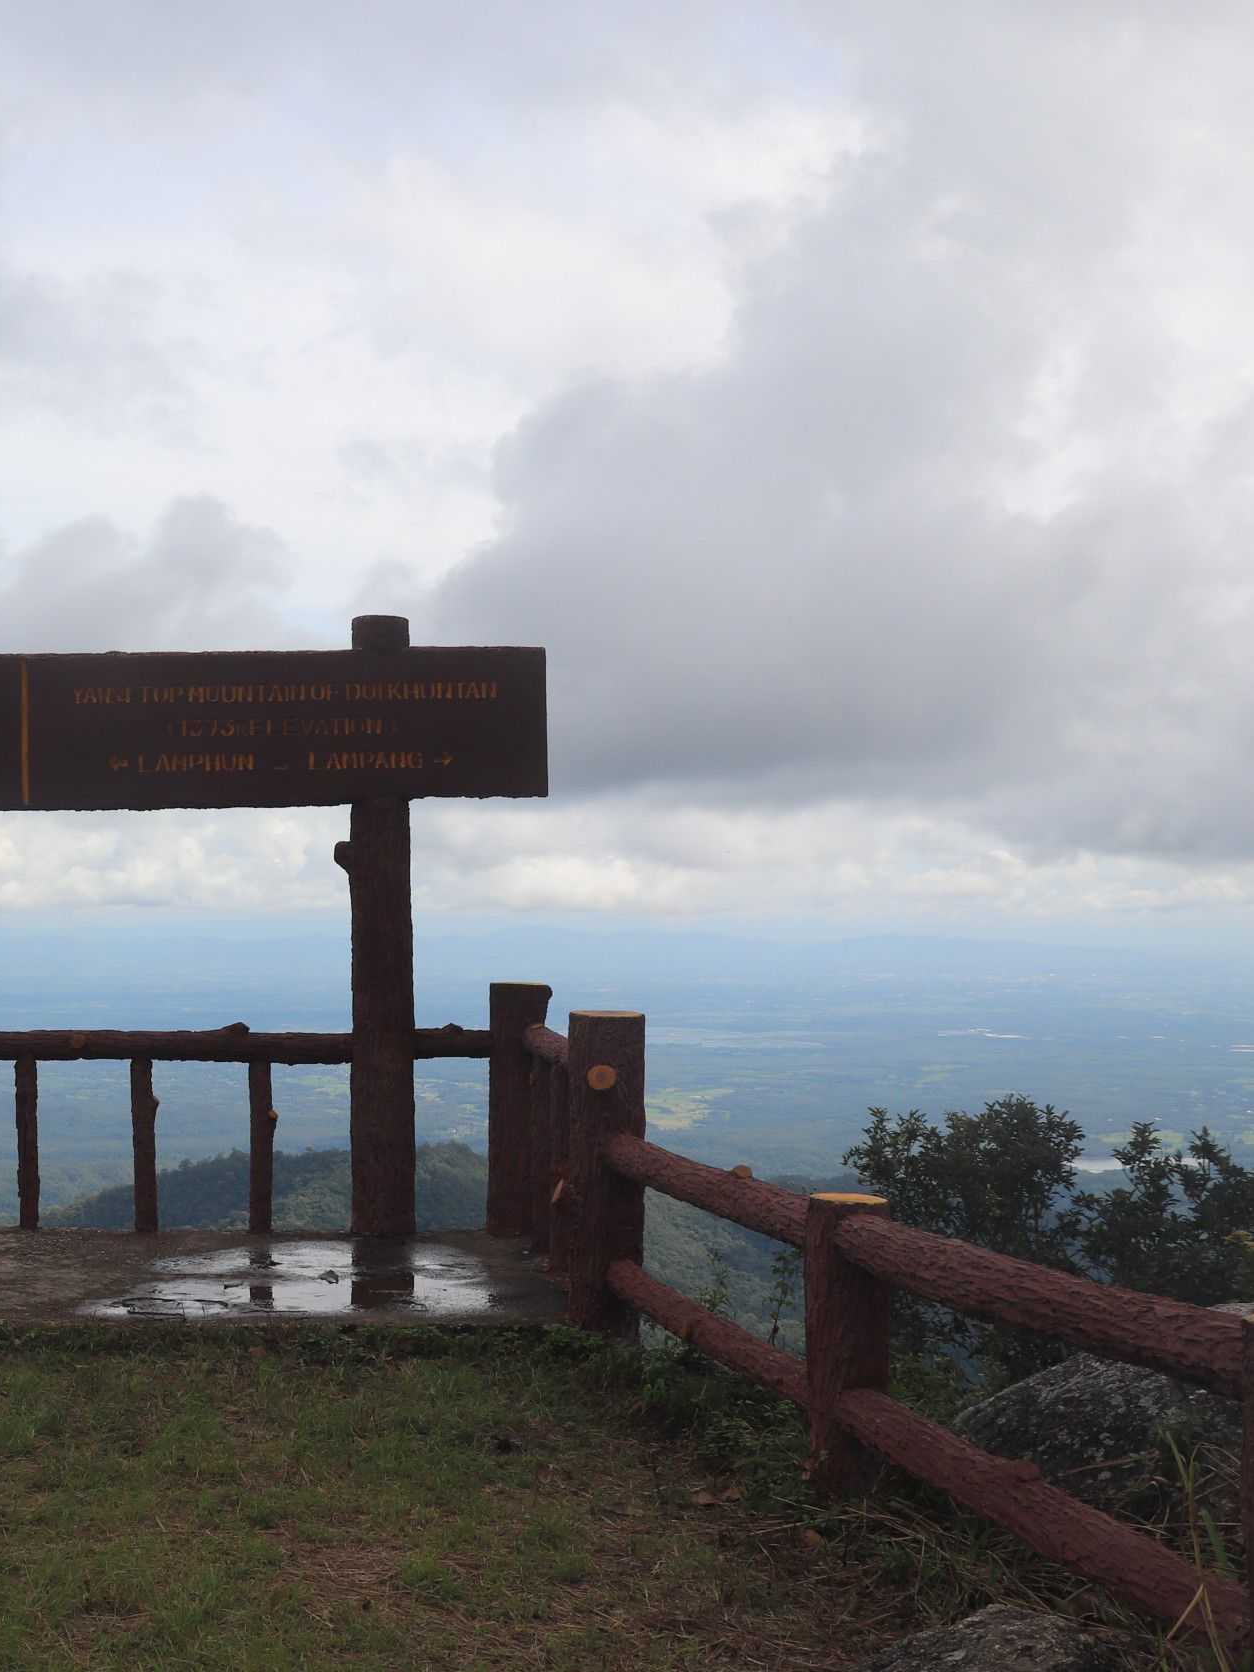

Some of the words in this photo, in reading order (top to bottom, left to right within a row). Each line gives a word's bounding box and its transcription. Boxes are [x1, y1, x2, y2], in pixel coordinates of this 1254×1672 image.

[137, 685, 184, 704] TOP
[187, 682, 306, 704] MOUNTAIN
[310, 682, 338, 701] OF
[344, 681, 383, 700] DOI
[387, 680, 498, 700] KHUNTAN
[137, 753, 255, 773] LAMPHUN
[308, 751, 424, 770] LAMPANG
